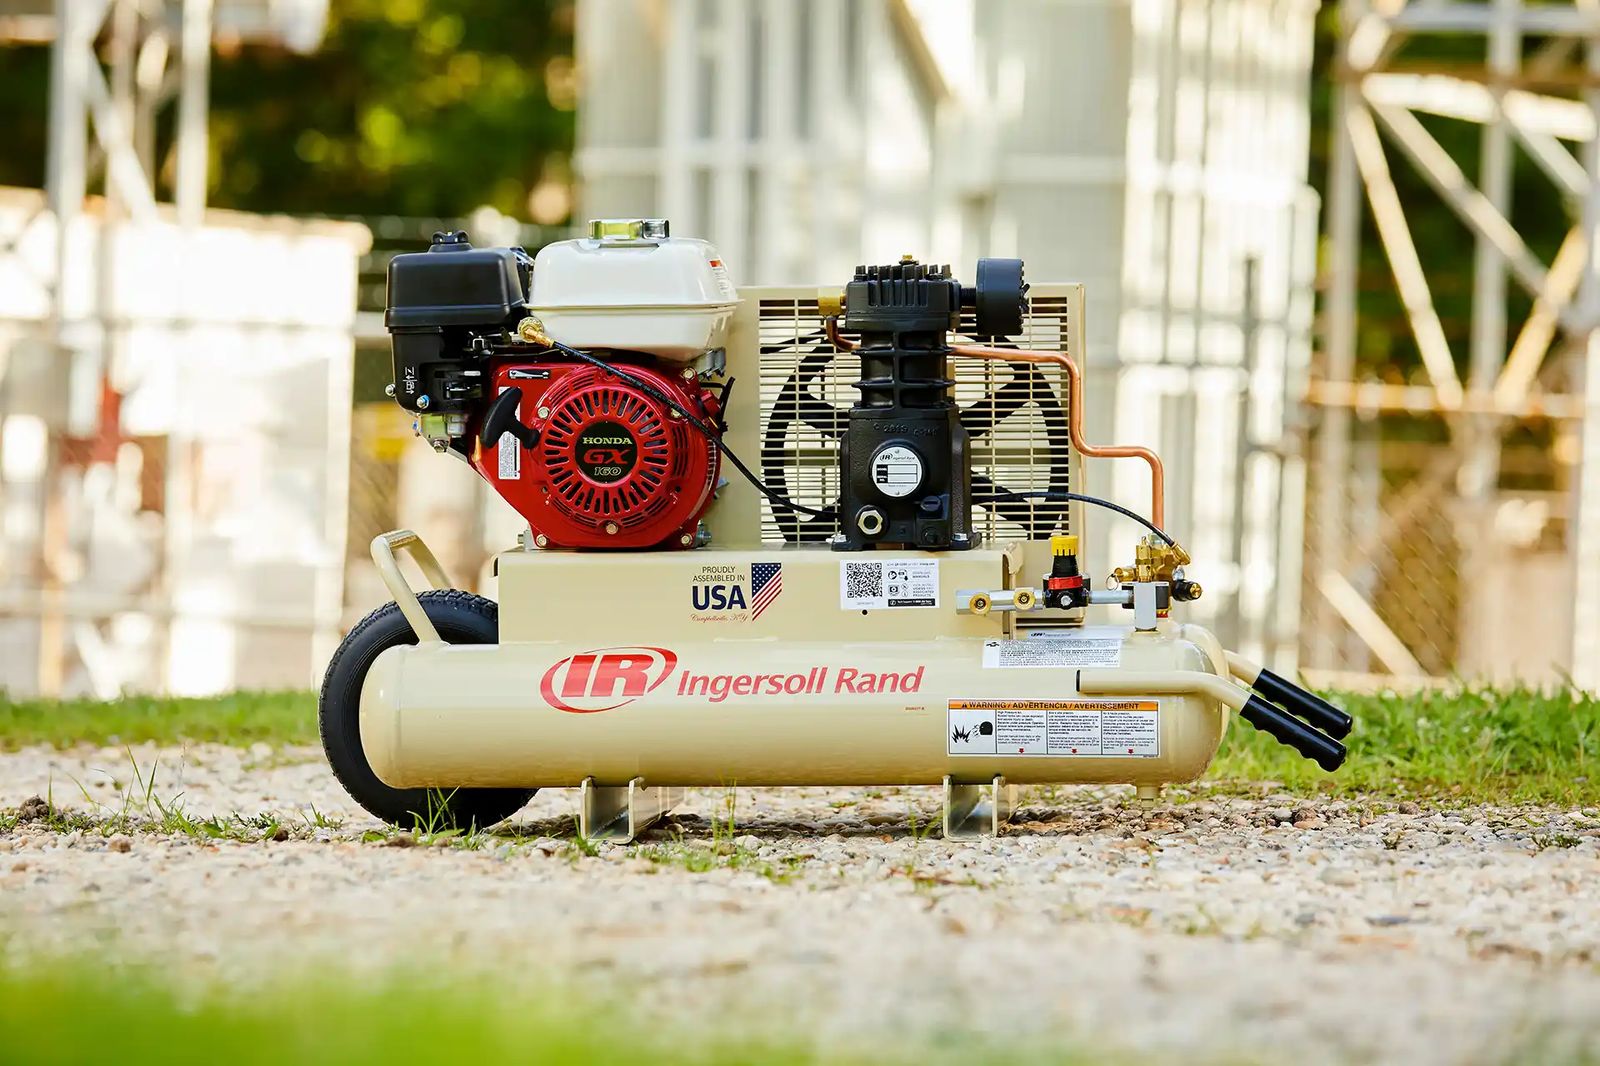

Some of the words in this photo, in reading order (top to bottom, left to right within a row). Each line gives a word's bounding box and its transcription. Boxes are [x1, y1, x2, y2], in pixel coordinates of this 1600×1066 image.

[582, 436, 632, 445] HONDA
[584, 448, 631, 464] GX
[594, 466, 622, 476] 160
[702, 566, 736, 574] PROUDLY
[692, 574, 736, 582] ASSEMBLED
[692, 585, 747, 610] USA
[561, 654, 655, 698] IR
[677, 667, 827, 703] Ingersoll
[834, 665, 925, 694] Rand
